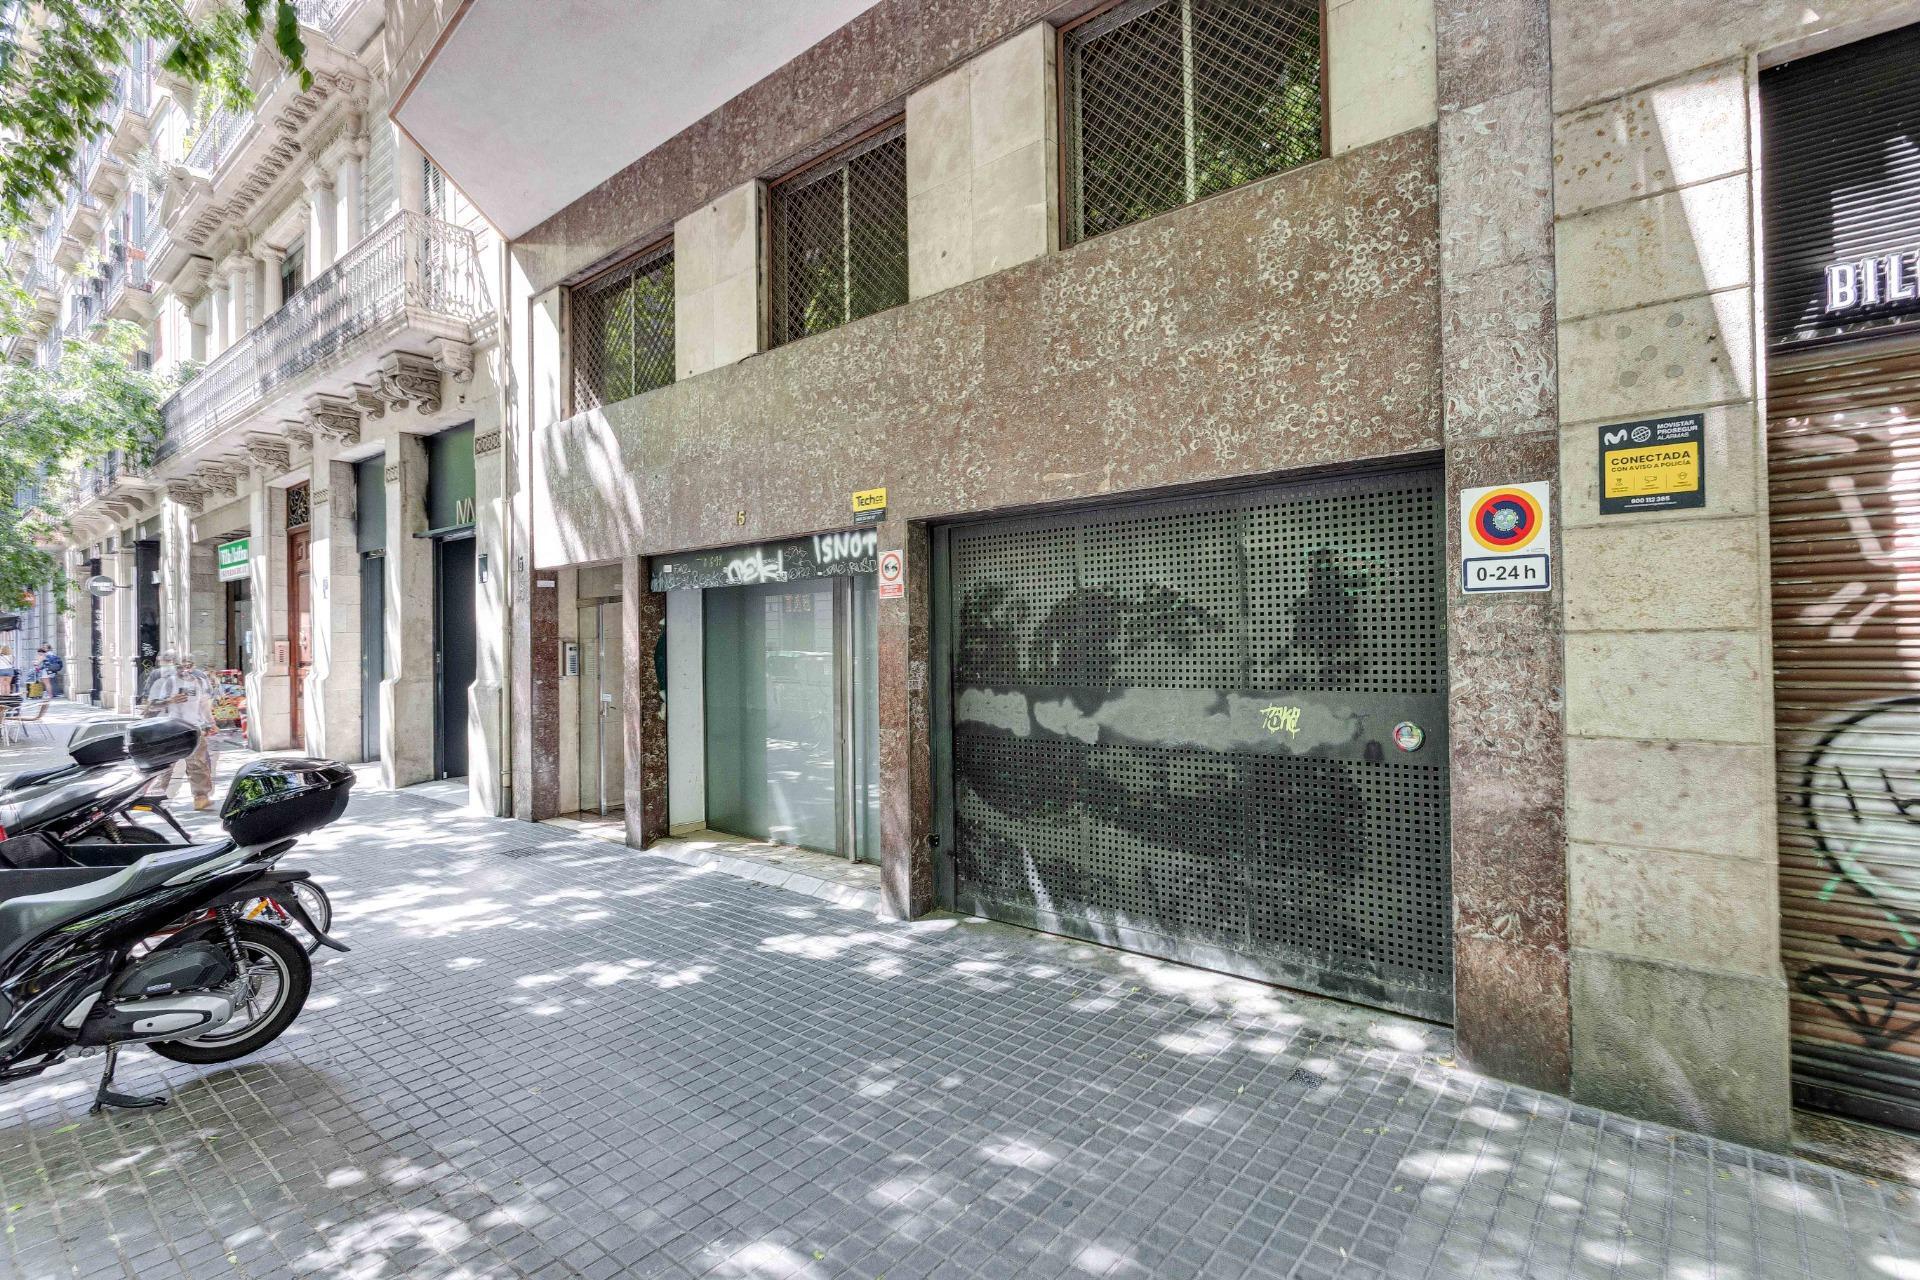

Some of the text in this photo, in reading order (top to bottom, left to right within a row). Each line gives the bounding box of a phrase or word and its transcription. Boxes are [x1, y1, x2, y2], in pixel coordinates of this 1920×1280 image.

[1825, 248, 1920, 314] BIL
[1657, 420, 1695, 429] MOVISTAR
[1657, 425, 1698, 435] PROSEGUR
[1657, 432, 1690, 440] ALARMAS
[1611, 451, 1691, 466] CONECTADA
[1629, 463, 1652, 471] AVISO
[1476, 564, 1537, 581] 0-24 h
